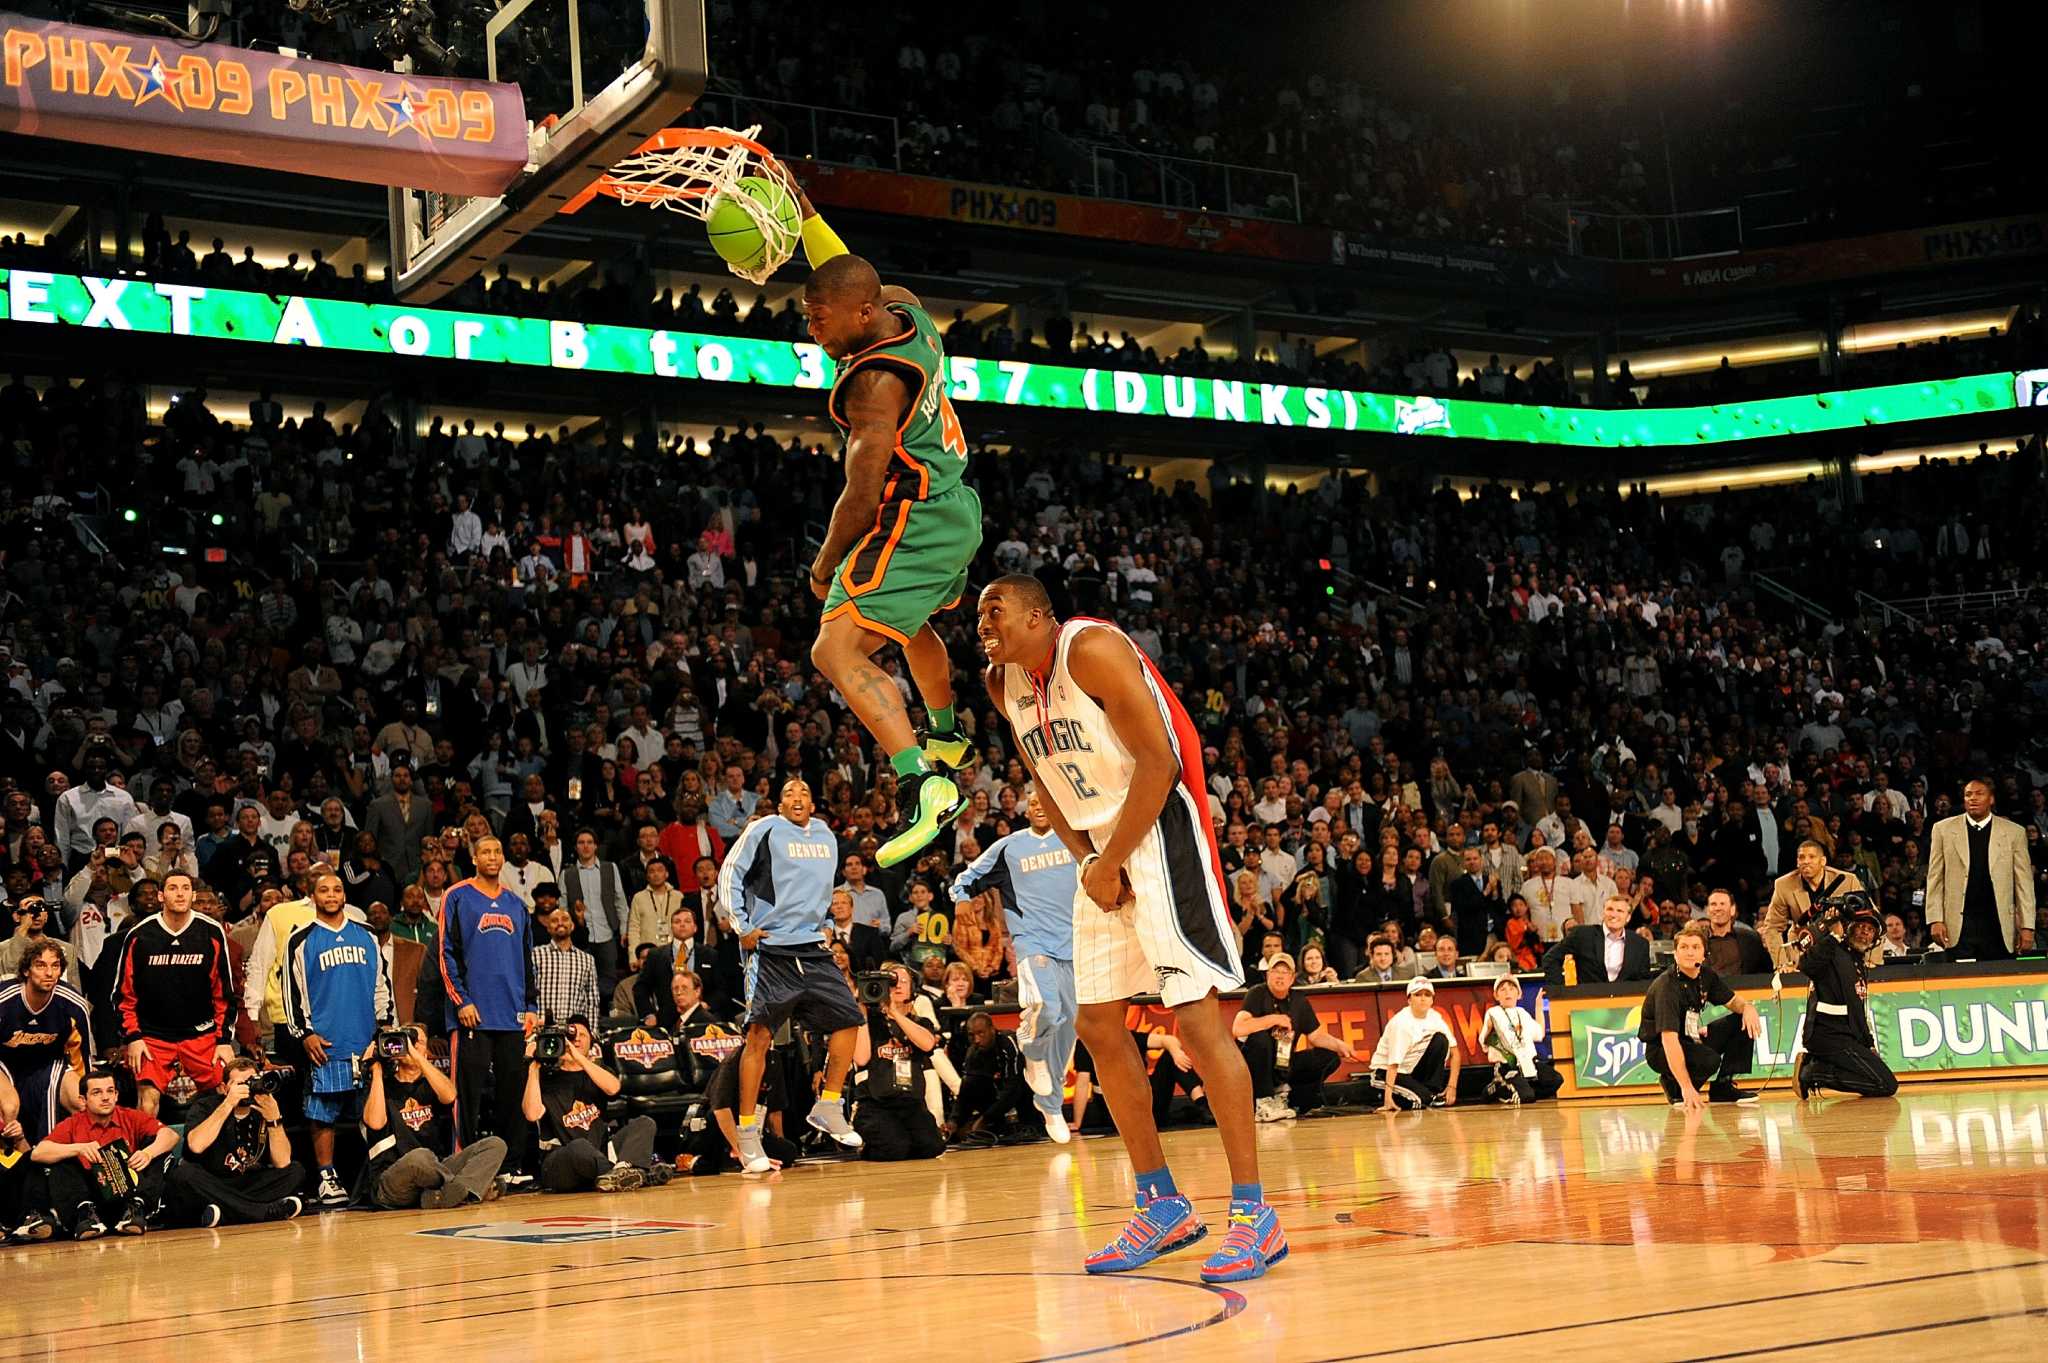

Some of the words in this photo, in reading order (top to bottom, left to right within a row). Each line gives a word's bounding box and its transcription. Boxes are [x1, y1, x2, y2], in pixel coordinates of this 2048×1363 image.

[4, 29, 136, 100] PHX
[177, 55, 253, 115] 09
[268, 68, 388, 132] PHX
[424, 88, 496, 143] 09
[952, 188, 1000, 219] PHX
[274, 296, 323, 347] A
[389, 315, 484, 360] or
[551, 320, 588, 369] B
[650, 330, 733, 381] to
[1082, 368, 1358, 430] (DUNKS)
[940, 383, 968, 460] 4
[1056, 762, 1100, 801] 12
[788, 842, 831, 858] DENVER
[1020, 849, 1071, 873] DENVER
[916, 911, 949, 944] 10
[148, 954, 169, 966] TRAIL
[170, 953, 204, 965] BLAZERS
[319, 946, 367, 971] MAGIC
